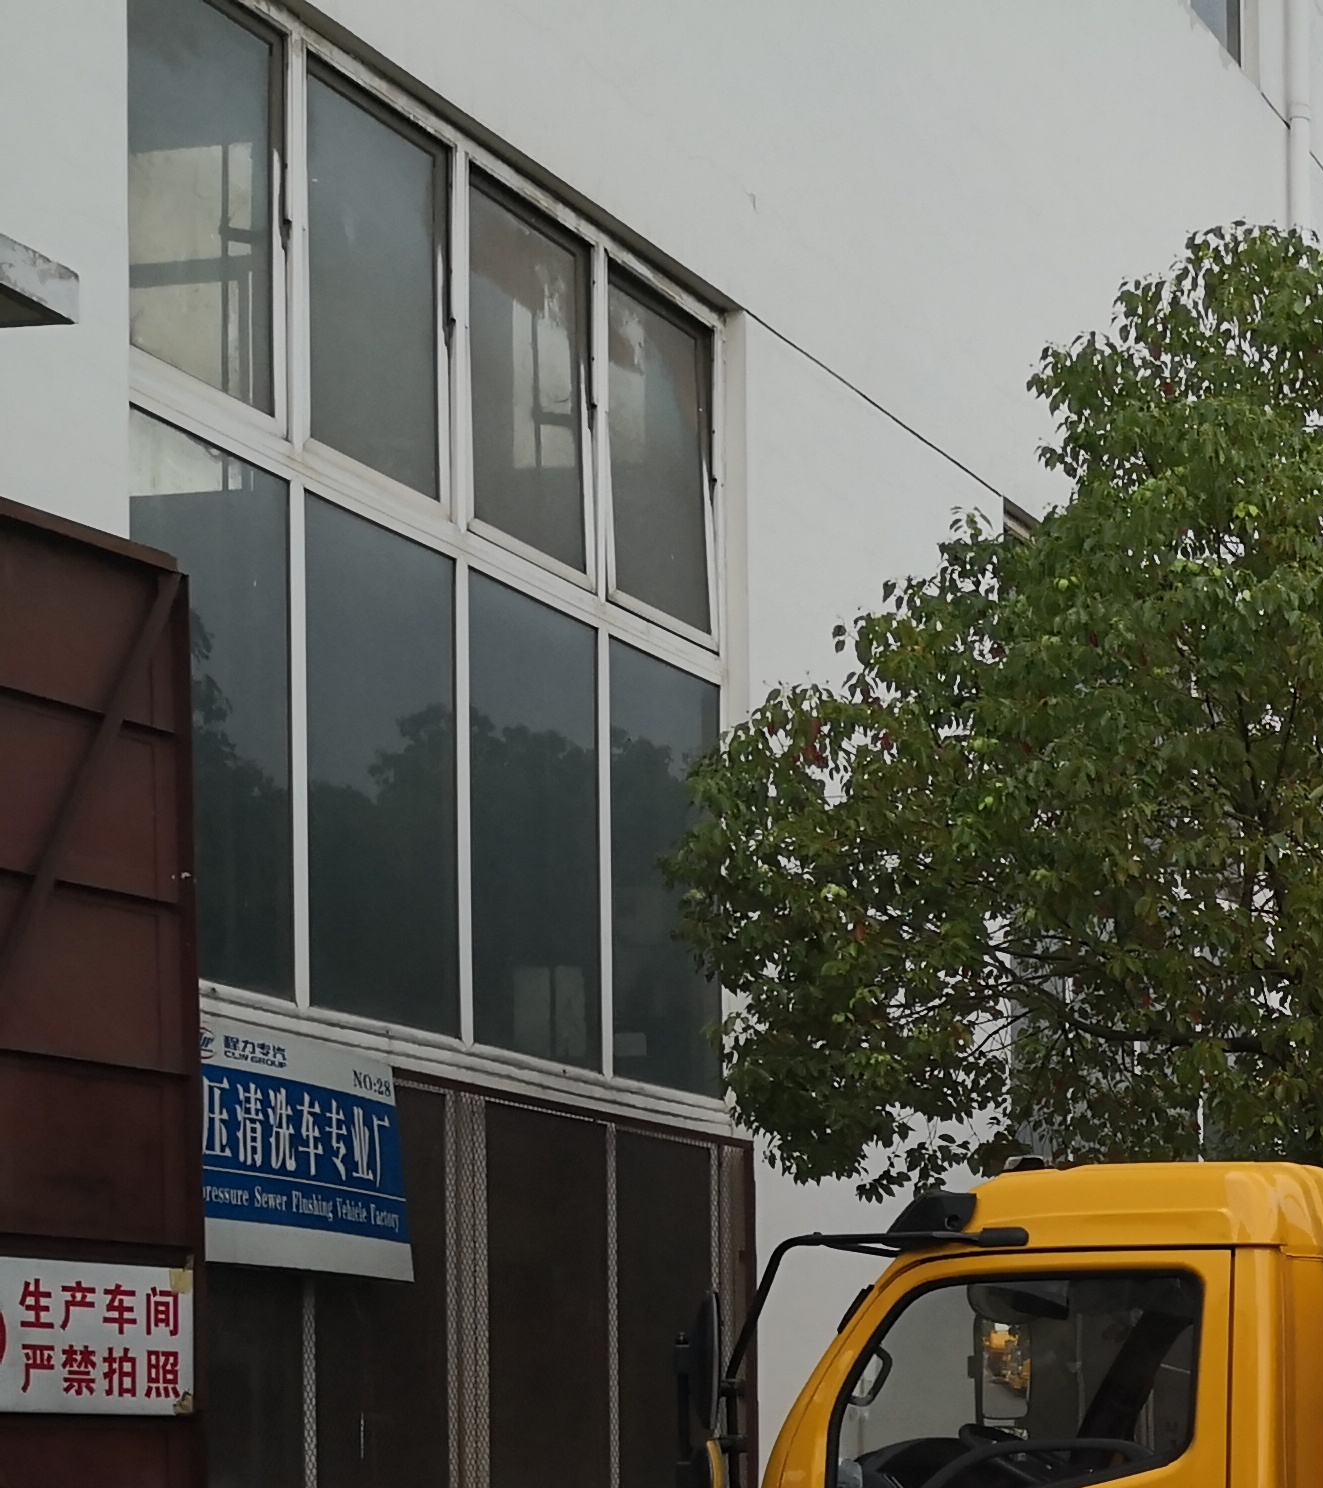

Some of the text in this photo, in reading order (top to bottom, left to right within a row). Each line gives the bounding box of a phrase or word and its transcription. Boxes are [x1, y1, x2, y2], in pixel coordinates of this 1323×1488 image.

[352, 1069, 391, 1097] NO:28
[254, 1185, 287, 1212] Sewer
[292, 1190, 333, 1222] Flushing
[336, 1197, 368, 1223] Vehicle
[370, 1203, 400, 1233] Factory
[19, 1278, 180, 1336] 生产车间
[21, 1344, 181, 1399] 严禁拍照
